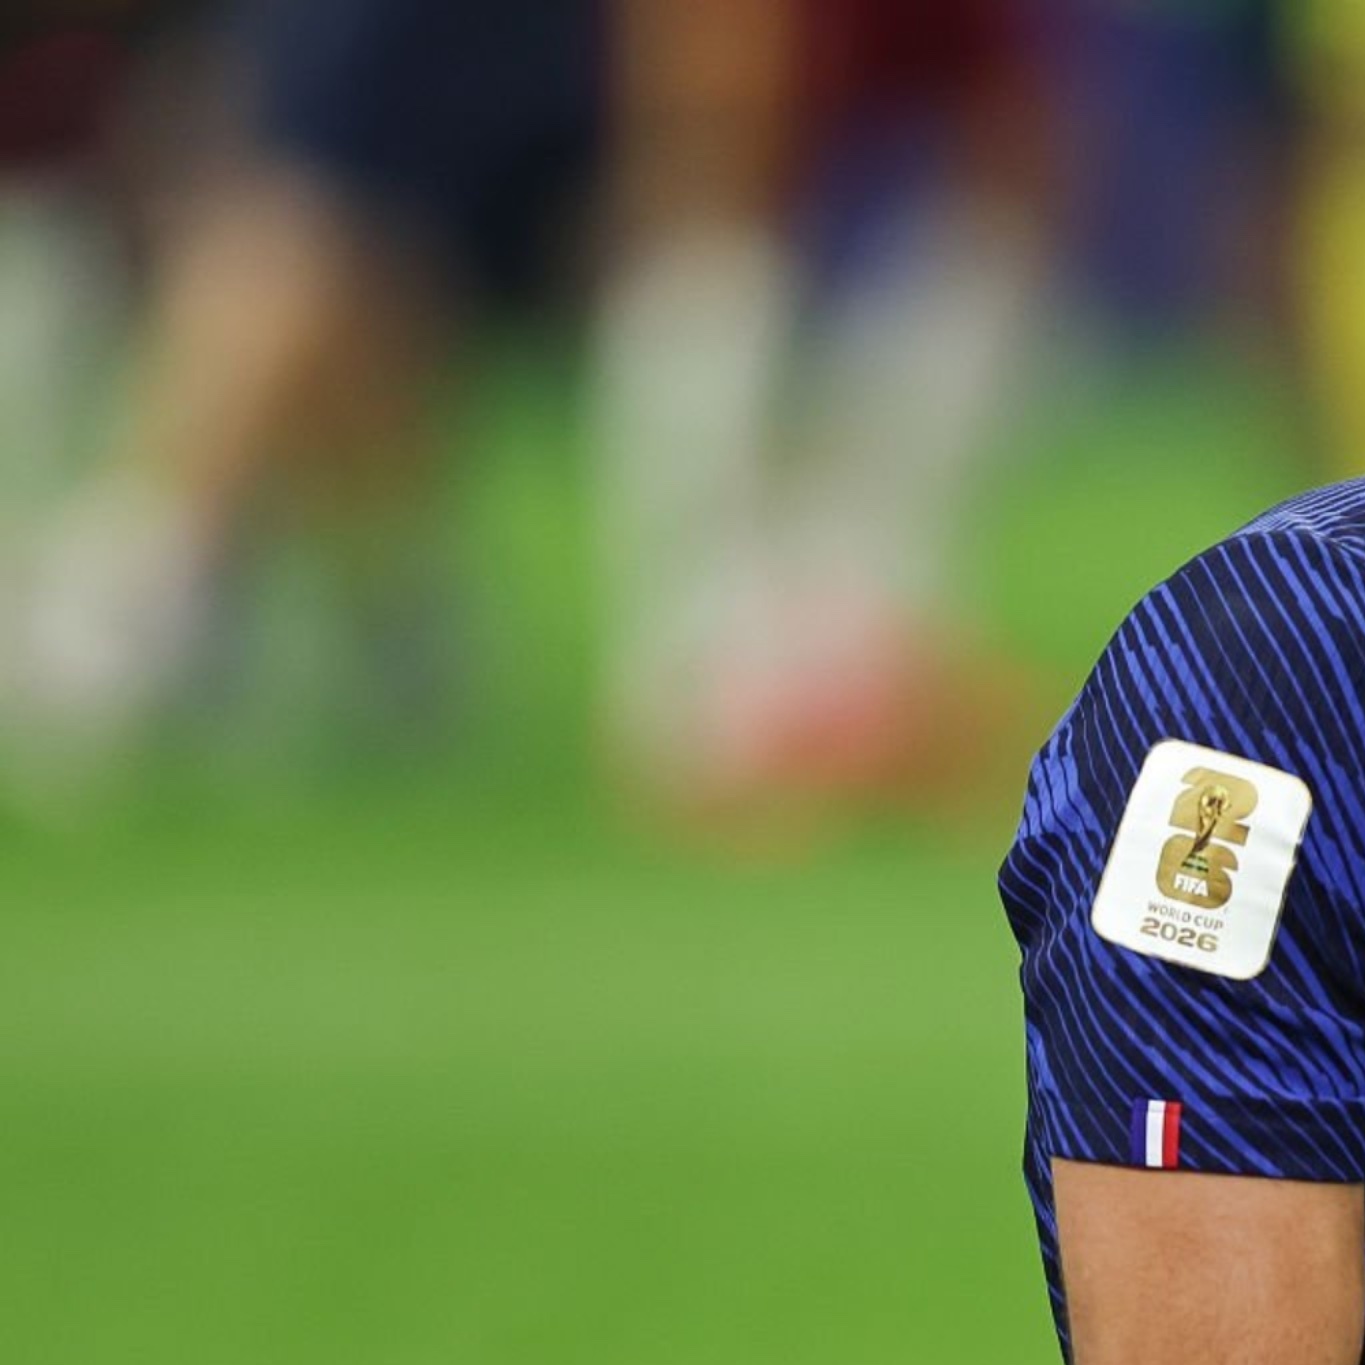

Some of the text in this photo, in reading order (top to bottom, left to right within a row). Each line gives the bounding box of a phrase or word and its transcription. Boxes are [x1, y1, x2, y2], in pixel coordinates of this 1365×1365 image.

[1173, 872, 1209, 897] FIFA
[1148, 900, 1223, 930] WORLD CUP
[1140, 917, 1218, 952] 2026
